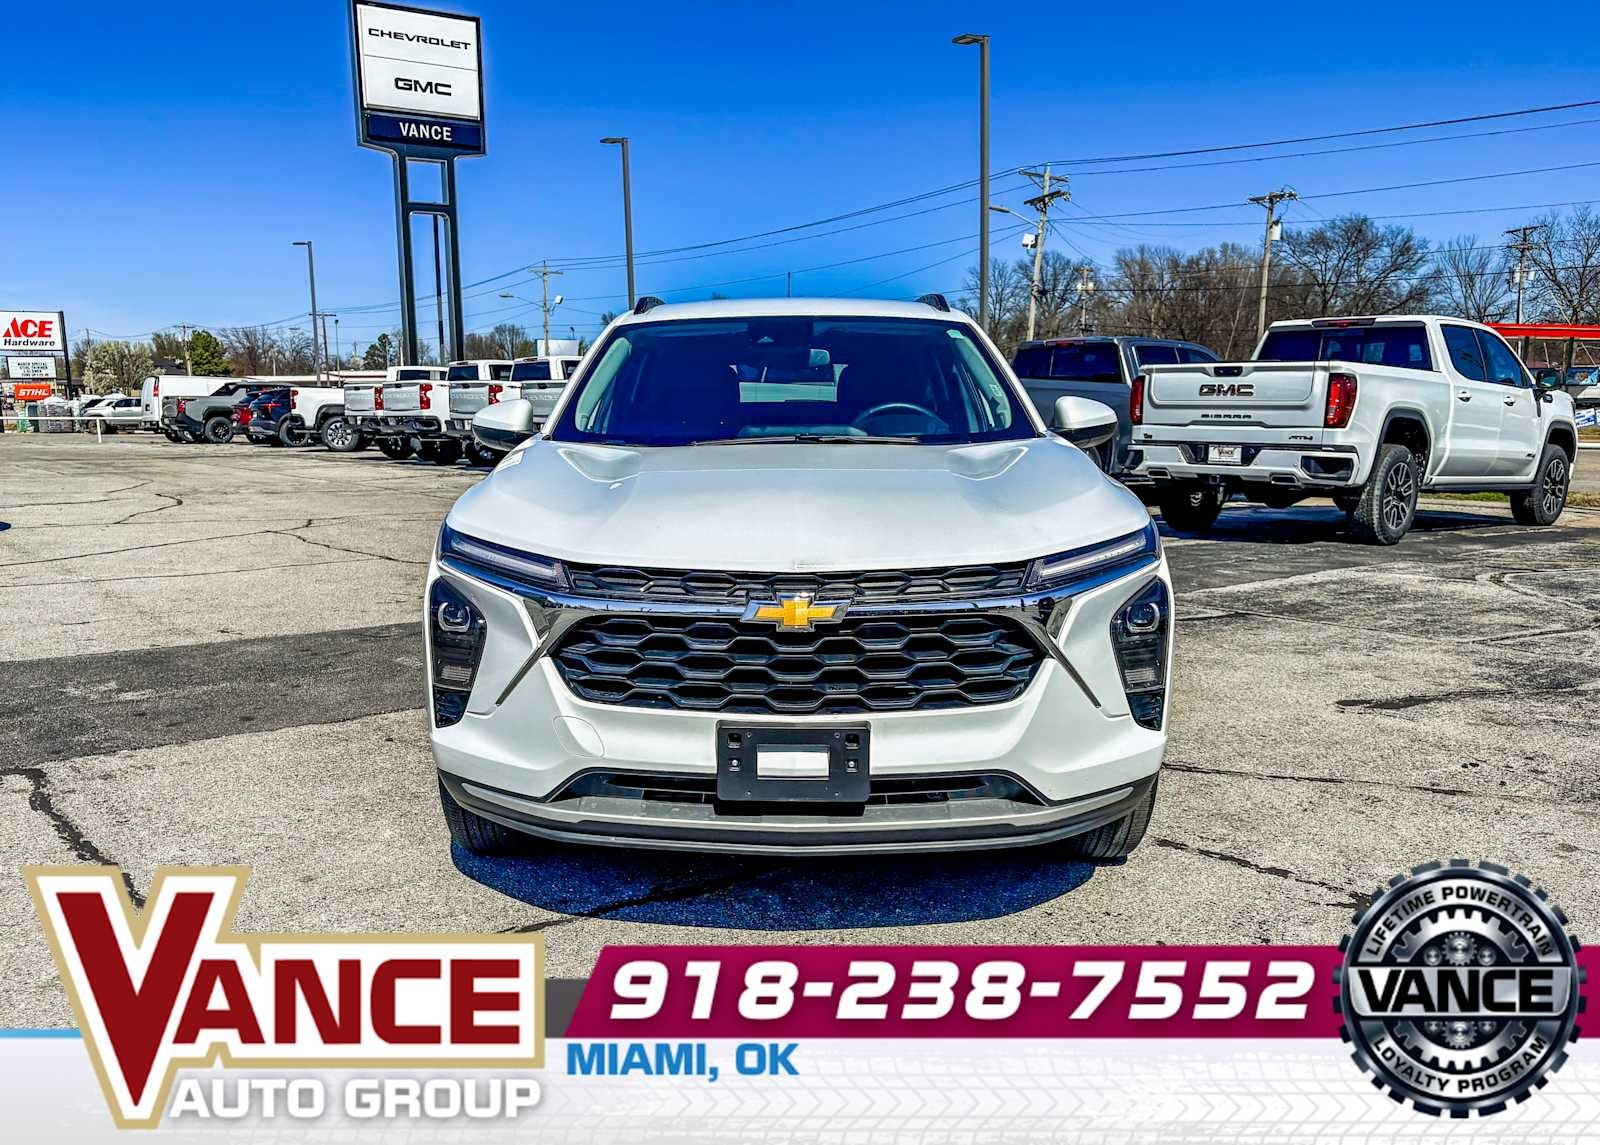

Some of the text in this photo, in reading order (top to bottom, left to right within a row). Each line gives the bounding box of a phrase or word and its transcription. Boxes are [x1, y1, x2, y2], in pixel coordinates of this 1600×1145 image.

[368, 28, 471, 50] CHEVROLET
[394, 77, 452, 97] GMC
[399, 121, 453, 141] VANCE
[2, 317, 53, 338] ACE
[3, 338, 56, 347] Hardware
[18, 388, 49, 396] STIHL
[1199, 384, 1254, 397] GMC
